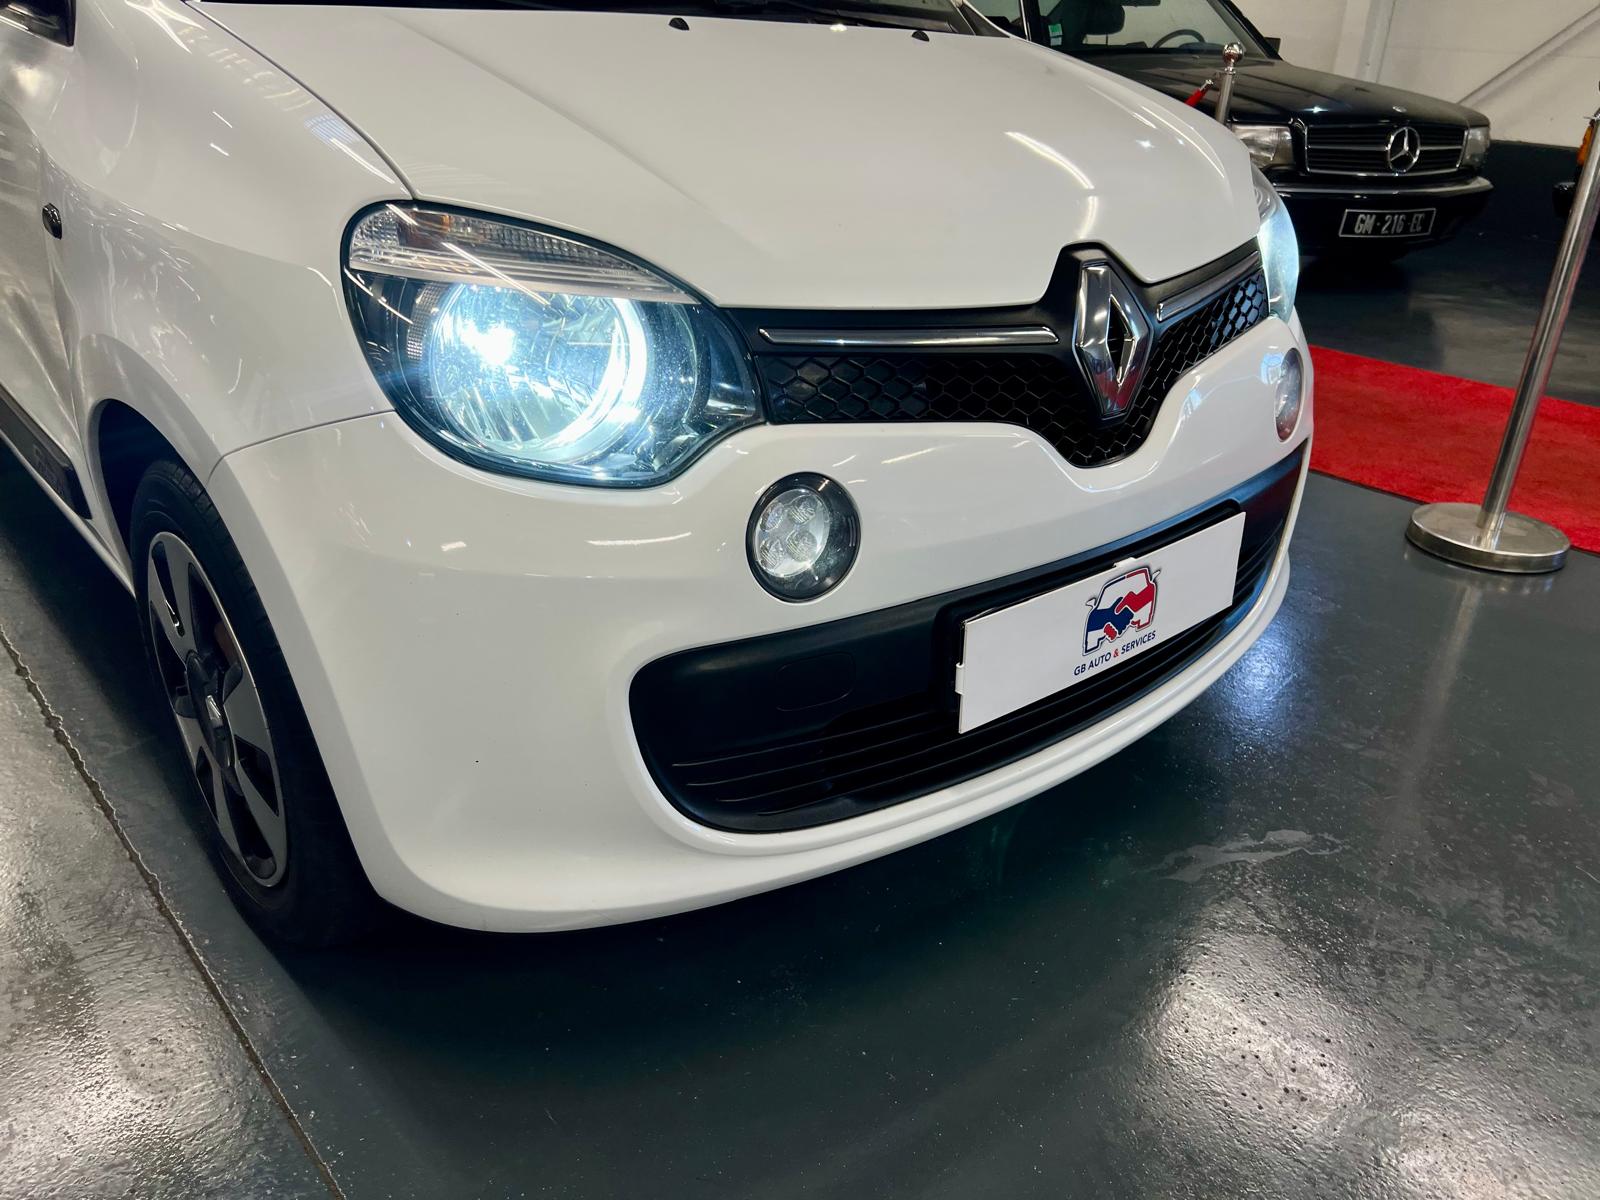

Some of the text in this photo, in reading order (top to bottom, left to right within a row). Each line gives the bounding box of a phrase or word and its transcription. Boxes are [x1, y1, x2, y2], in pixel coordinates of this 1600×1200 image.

[1074, 630, 1156, 676] GB AUTO & SERVICES
